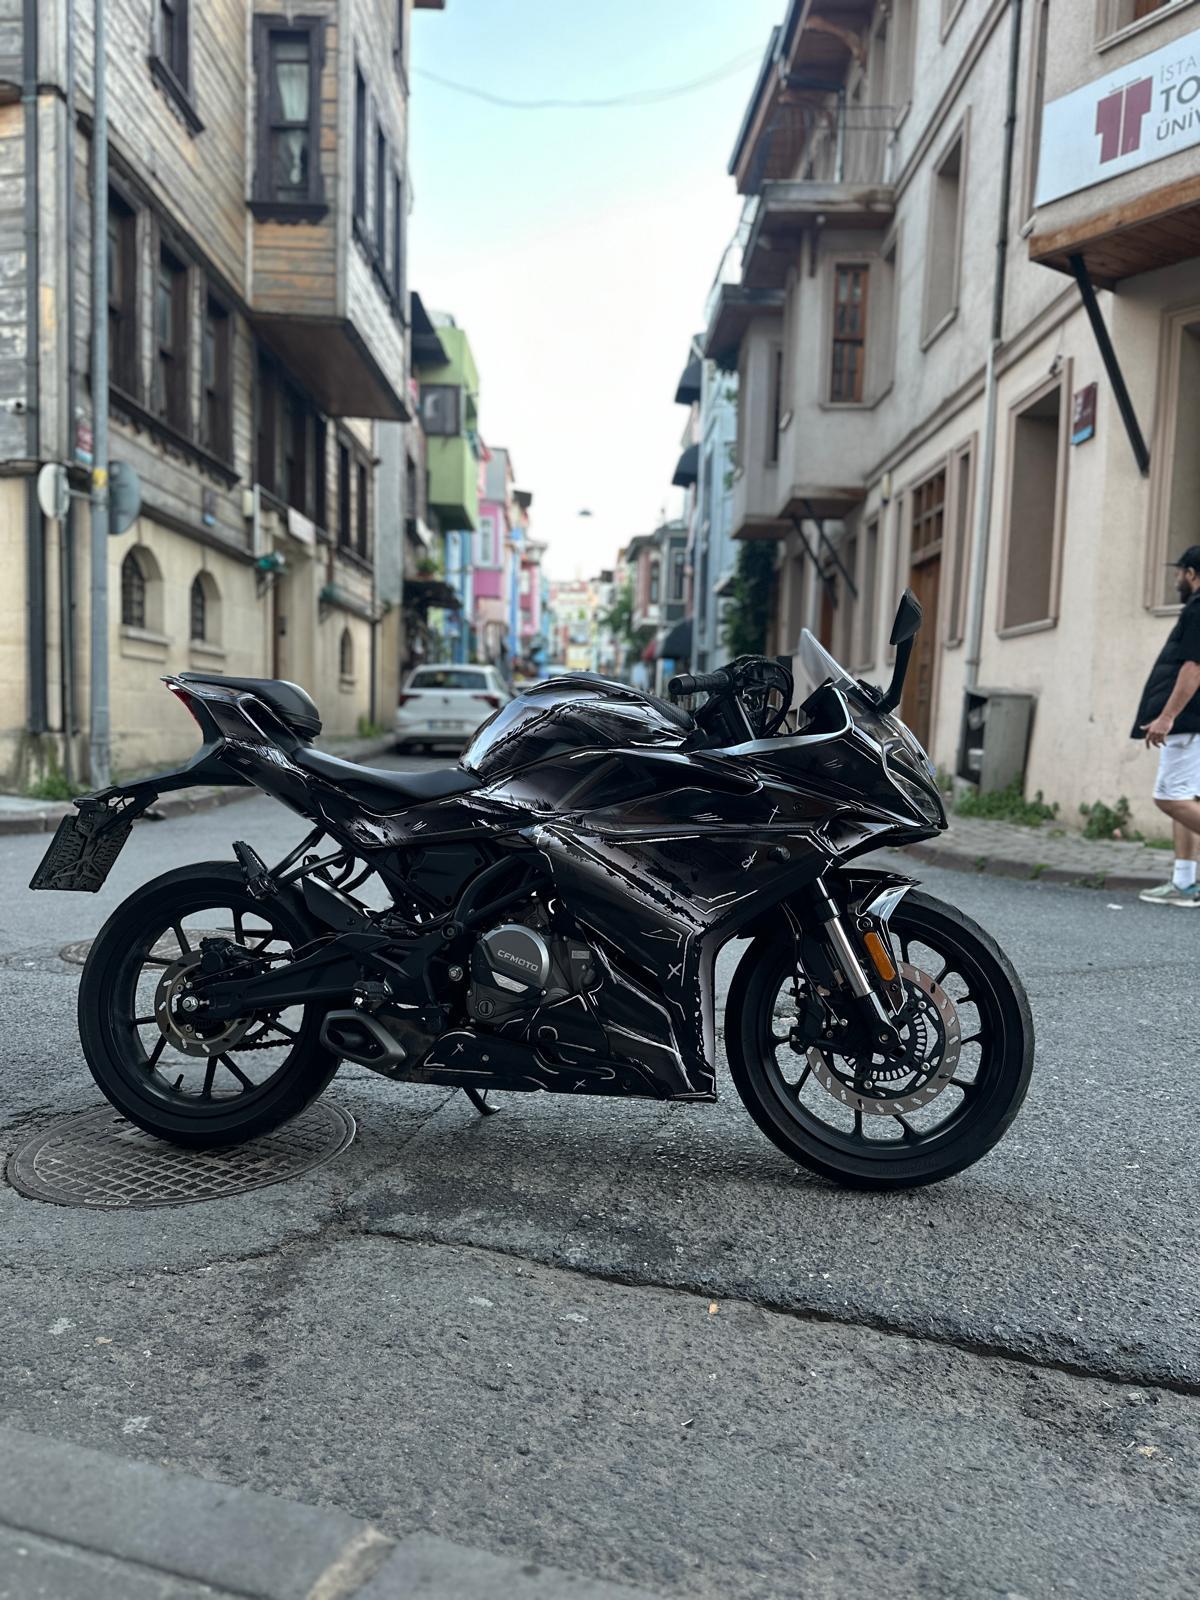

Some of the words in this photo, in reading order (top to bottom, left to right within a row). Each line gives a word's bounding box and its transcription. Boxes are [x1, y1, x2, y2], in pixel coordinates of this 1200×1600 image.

[1160, 55, 1197, 84] İSTA
[1160, 75, 1200, 112] TO
[497, 949, 539, 972] CFMOTO
